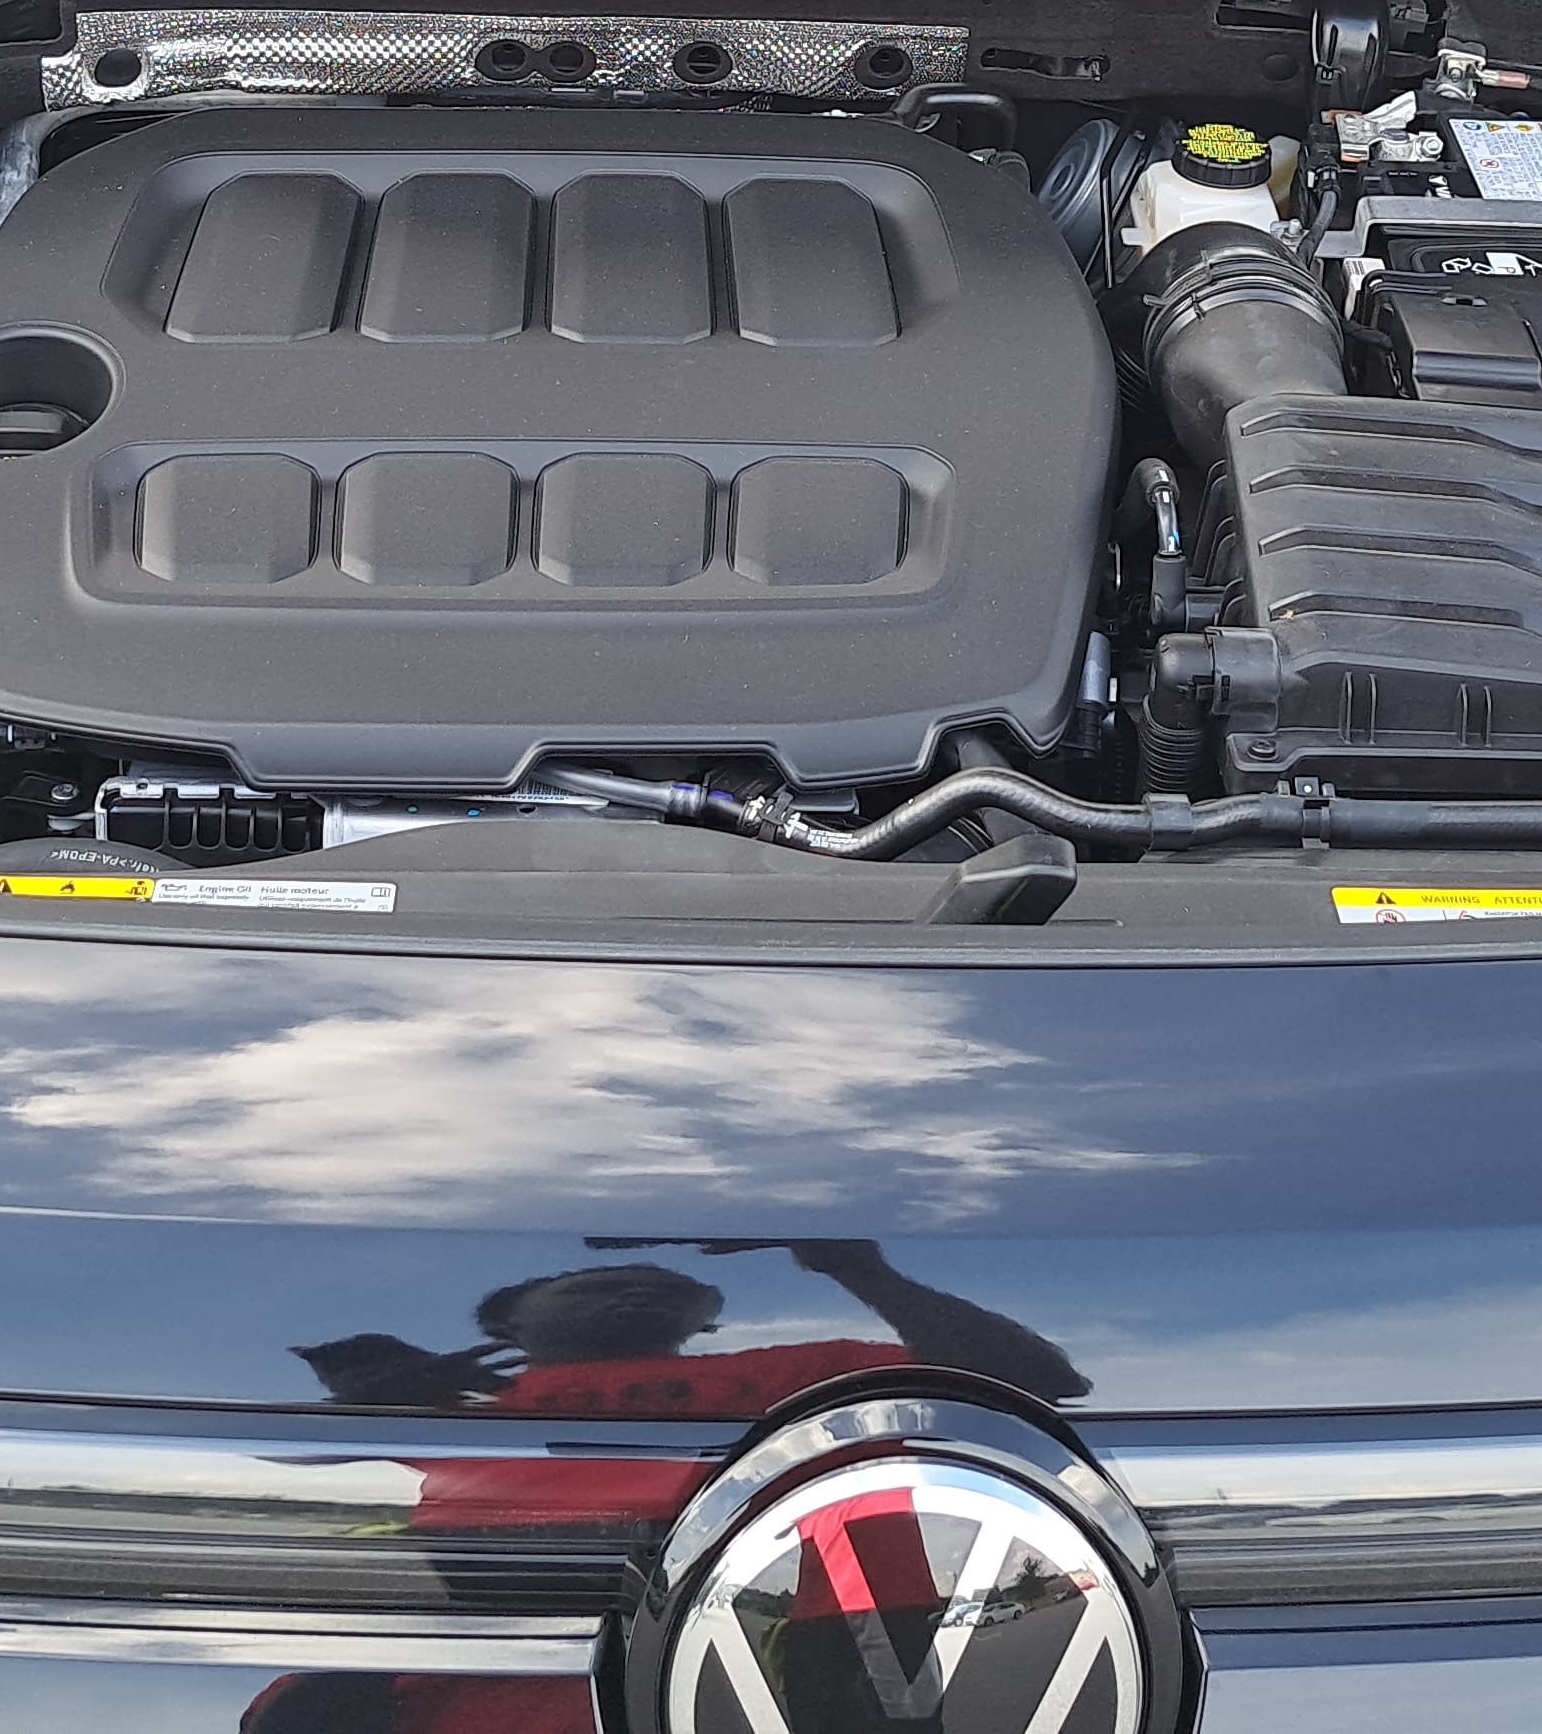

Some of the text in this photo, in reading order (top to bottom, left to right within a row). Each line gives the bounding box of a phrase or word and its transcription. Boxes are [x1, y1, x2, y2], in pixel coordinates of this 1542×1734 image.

[198, 884, 331, 896] Engine Oil Huile moteur
[1420, 894, 1481, 905] WARNING
